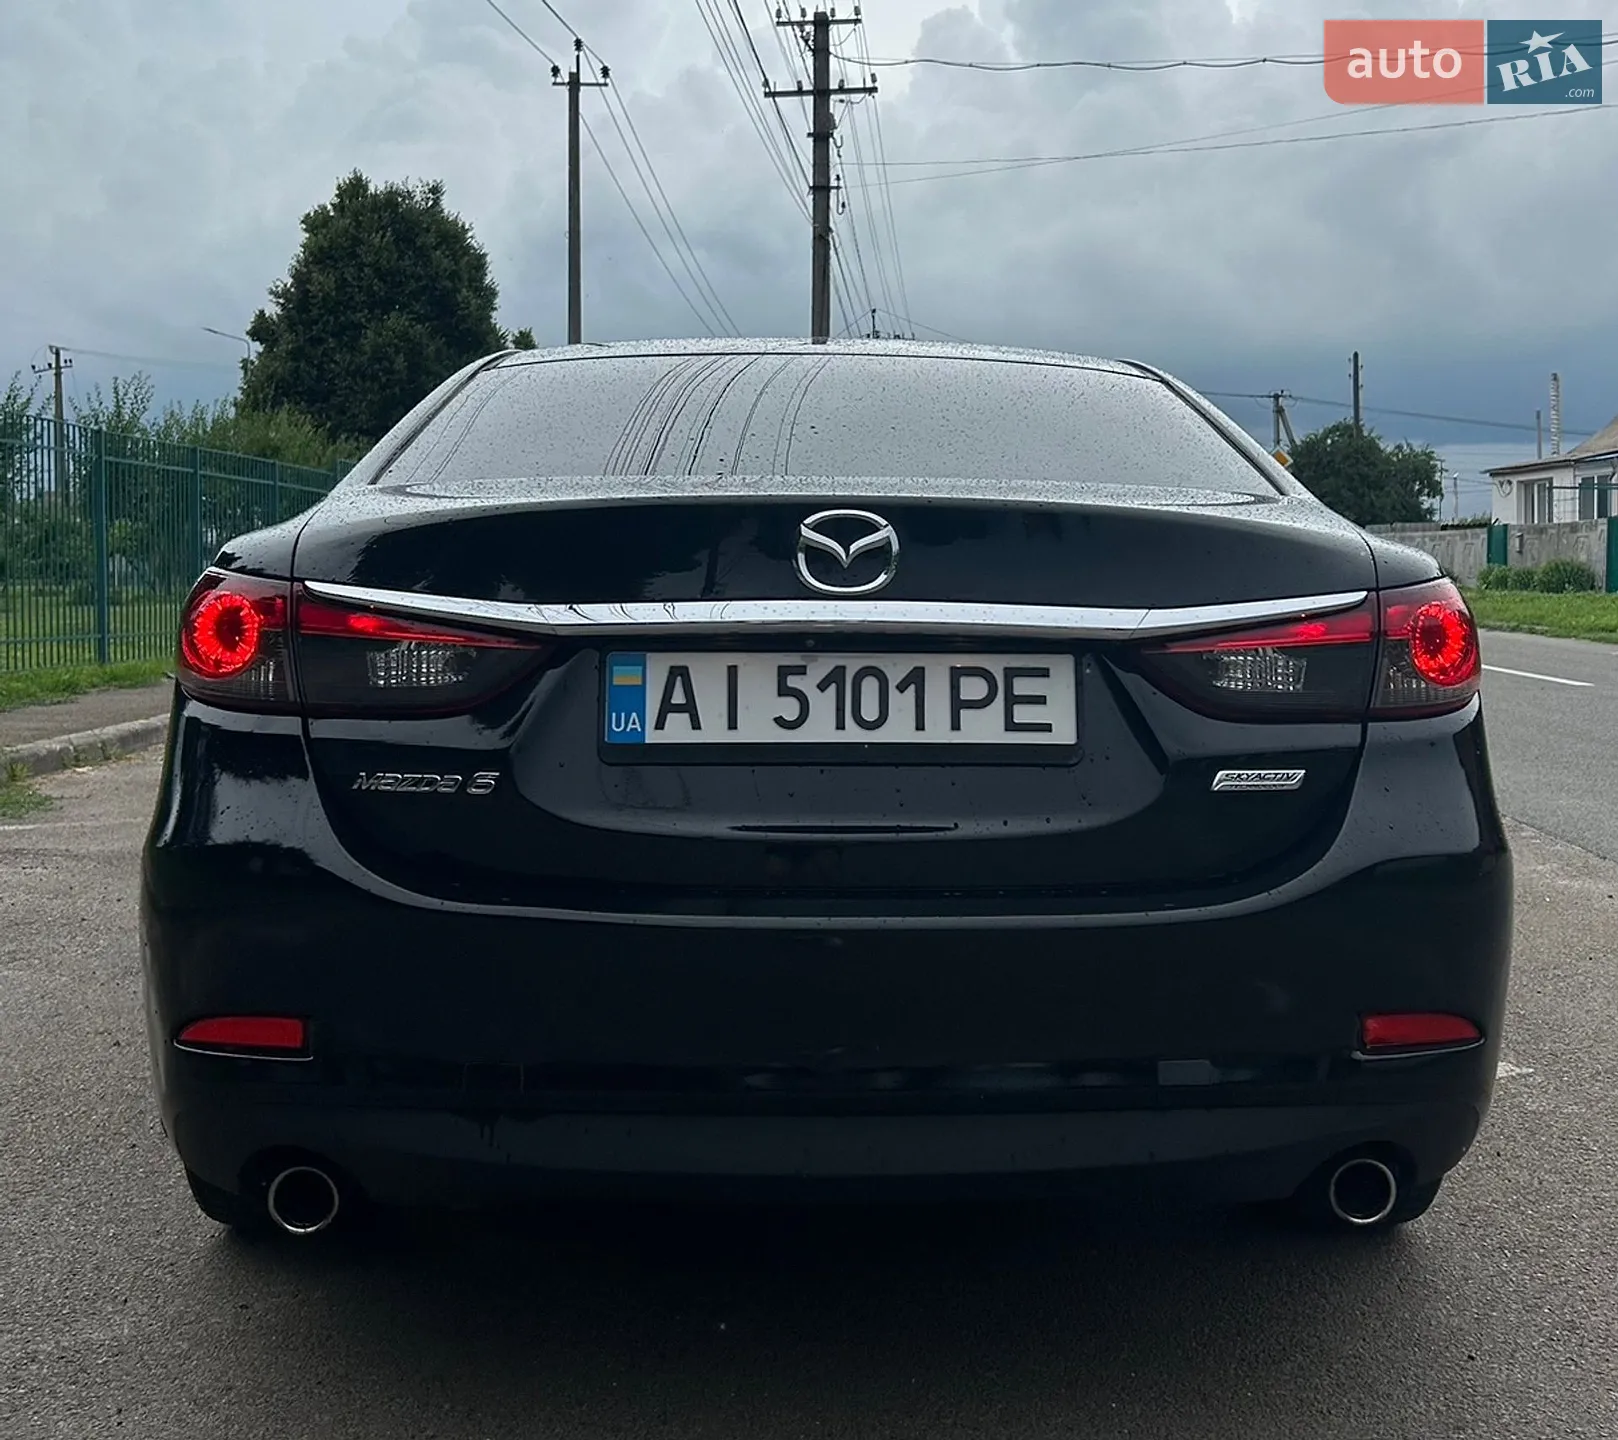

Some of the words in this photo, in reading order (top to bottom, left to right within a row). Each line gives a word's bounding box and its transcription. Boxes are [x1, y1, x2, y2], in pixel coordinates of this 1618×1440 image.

[653, 665, 739, 731] AI
[773, 665, 926, 731] 5101
[949, 665, 1053, 733] PE
[611, 712, 642, 733] UA
[466, 771, 500, 795] 6
[1221, 771, 1300, 783] SKYACTIV
